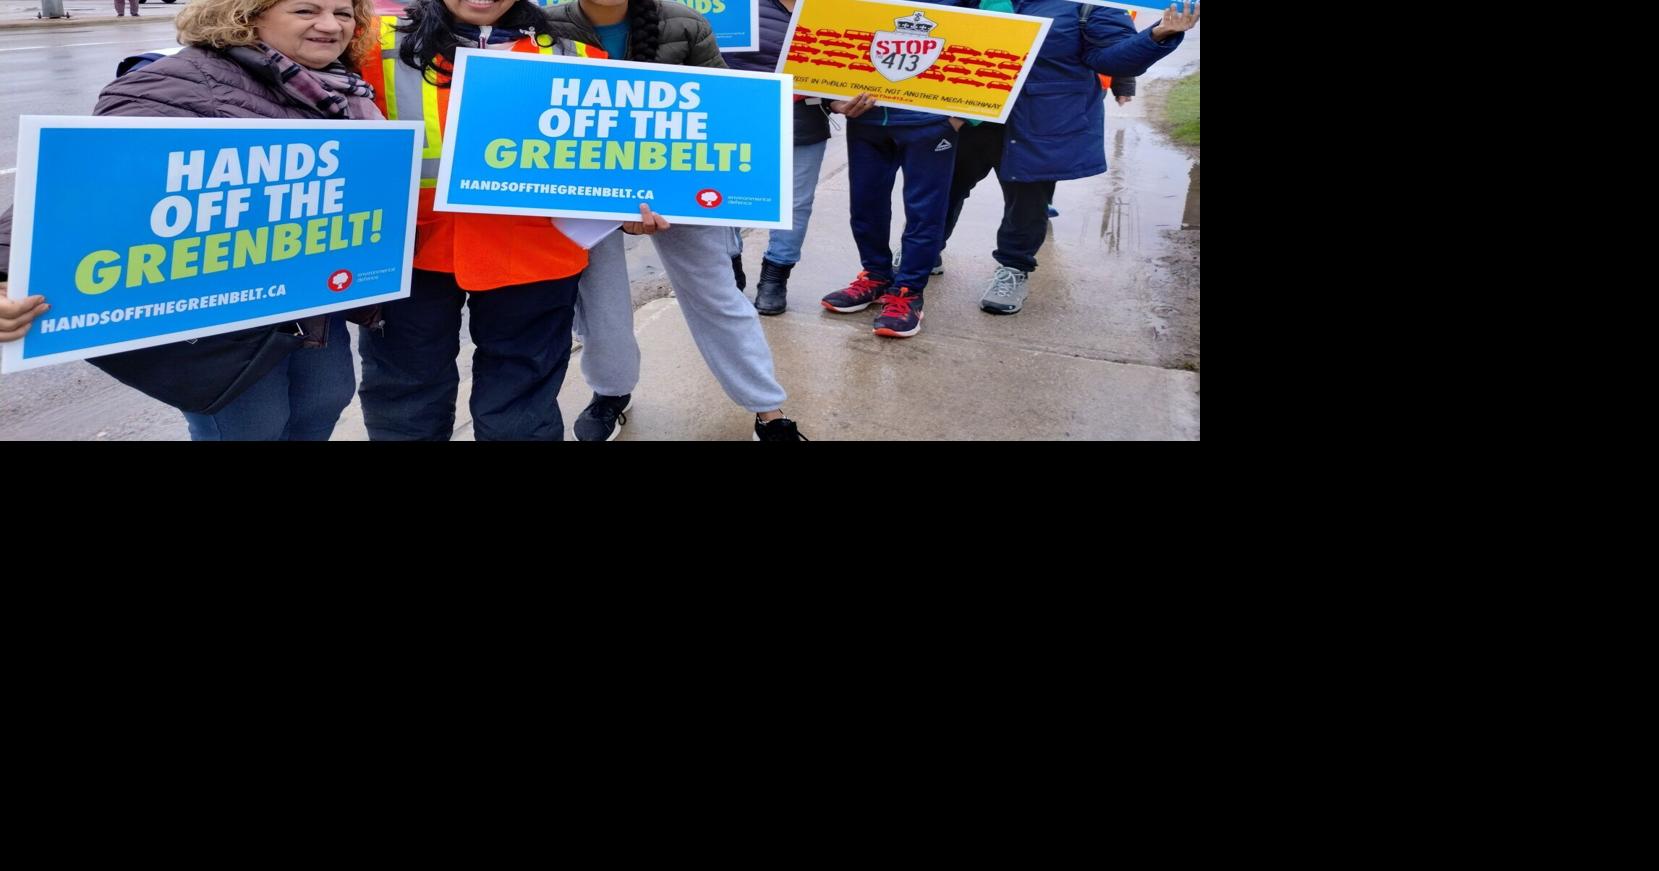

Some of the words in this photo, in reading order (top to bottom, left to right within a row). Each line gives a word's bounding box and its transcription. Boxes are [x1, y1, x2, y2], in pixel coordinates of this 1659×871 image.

[876, 39, 937, 55] STOP
[881, 52, 920, 72] 413
[550, 77, 701, 110] HANDS
[821, 78, 848, 88] PUBLIC
[904, 90, 939, 100] ANOTHER
[941, 96, 1001, 109] MEGA-HIGHWAY
[538, 108, 619, 138] OFF
[630, 111, 708, 140] THE
[166, 140, 340, 193] HANDS
[484, 138, 752, 173] GREENBELT!
[460, 179, 655, 201] HANDSOFFTHEGREENBELT.CA
[150, 187, 251, 238] OFF
[264, 178, 346, 223] THE
[74, 209, 383, 296] GREENBELT!
[40, 284, 287, 334] HANDSOFFTHEGREENBELT.CA
